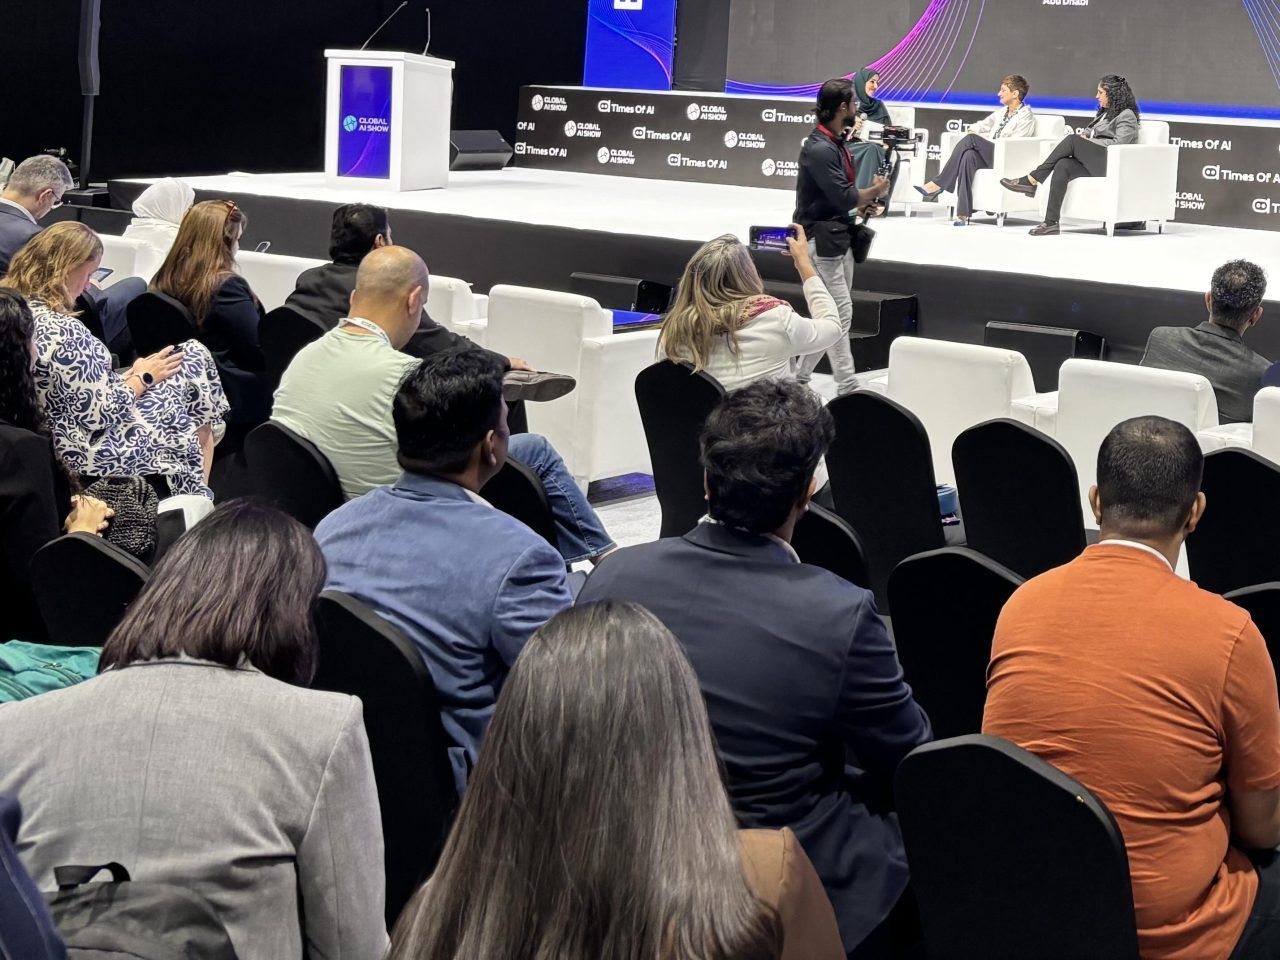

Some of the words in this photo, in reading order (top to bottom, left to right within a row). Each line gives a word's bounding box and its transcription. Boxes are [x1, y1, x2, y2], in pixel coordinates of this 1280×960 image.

[611, 104, 634, 113] Times
[635, 105, 646, 114] Of
[647, 106, 654, 114] AI
[1221, 170, 1254, 182] Times
[1256, 172, 1271, 183] Of
